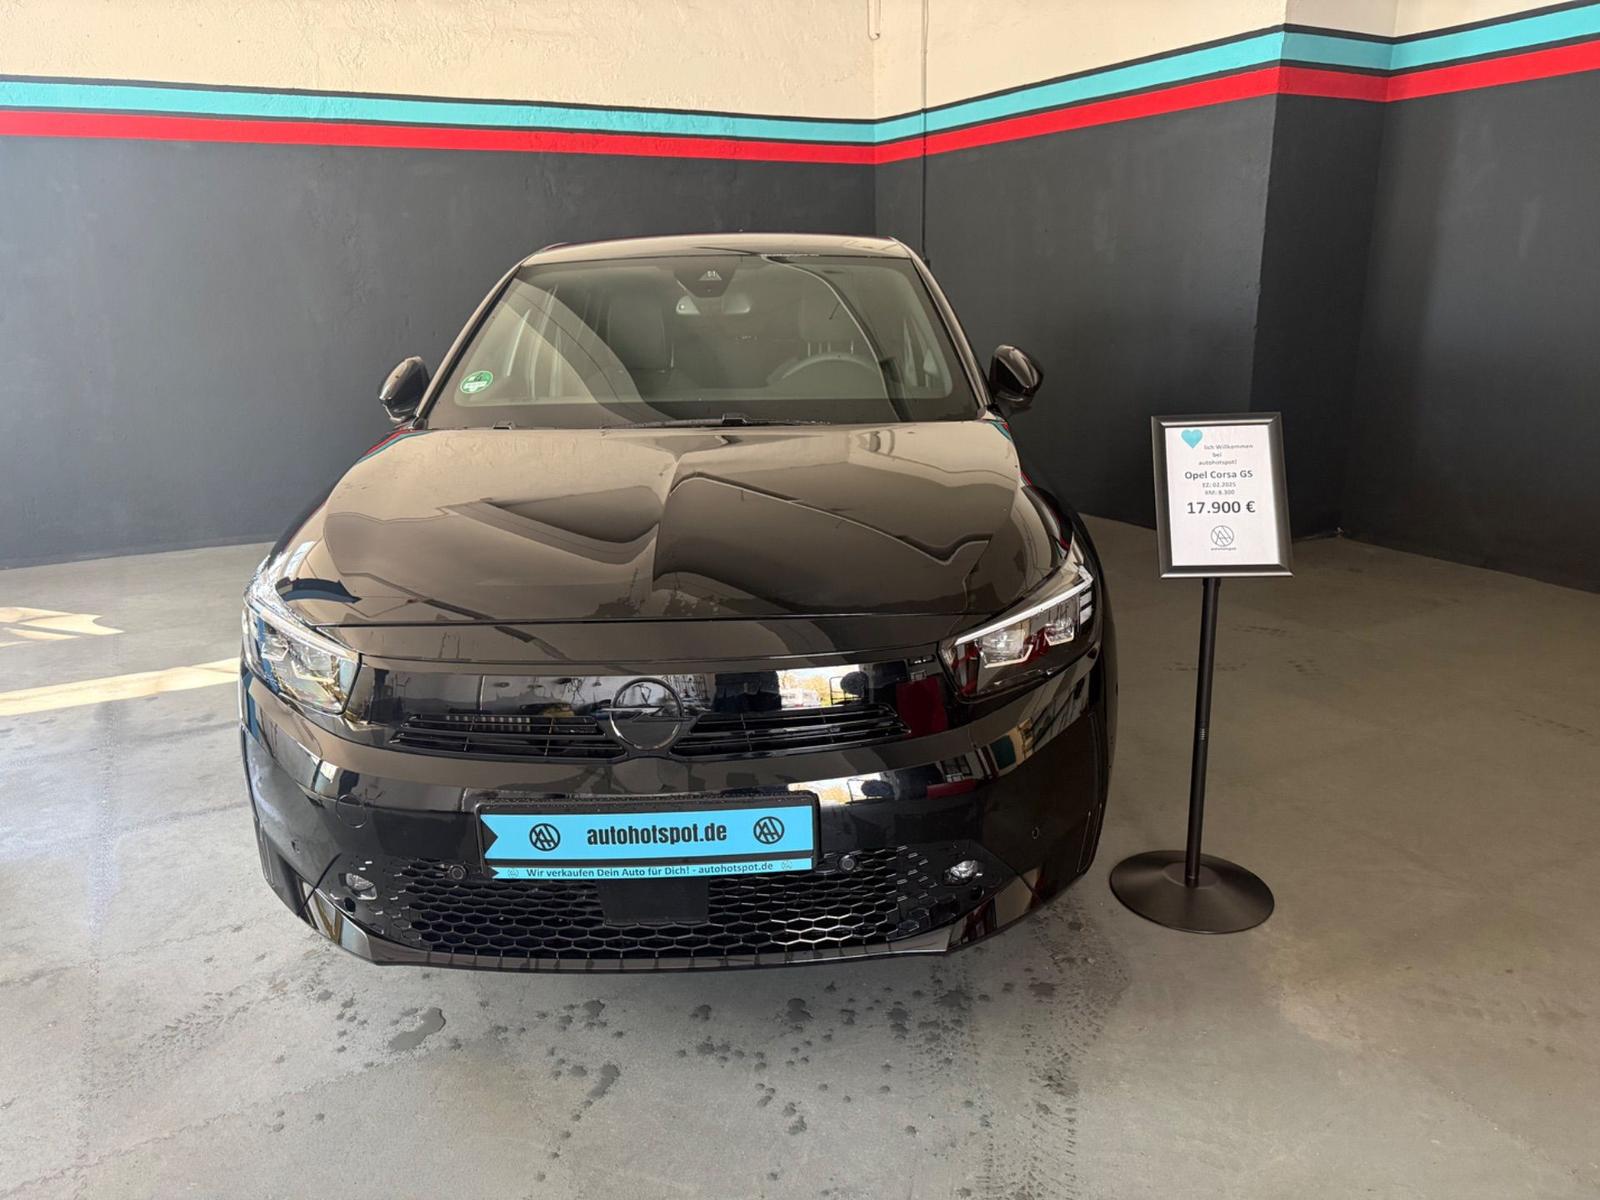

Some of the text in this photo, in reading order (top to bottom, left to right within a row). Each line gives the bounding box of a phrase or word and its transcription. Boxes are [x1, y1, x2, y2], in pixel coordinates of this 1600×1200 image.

[1184, 469, 1254, 480] Opel Corsa GS
[1187, 500, 1256, 514] 17.900 €
[586, 822, 728, 846] autohotspot.de
[526, 868, 544, 877] Wir
[546, 867, 594, 878] verkaufen
[596, 867, 619, 876] Dein
[621, 867, 646, 876] Auto
[648, 866, 662, 876] für
[664, 865, 690, 876] Dich!
[698, 861, 774, 874] autohotspot.de
